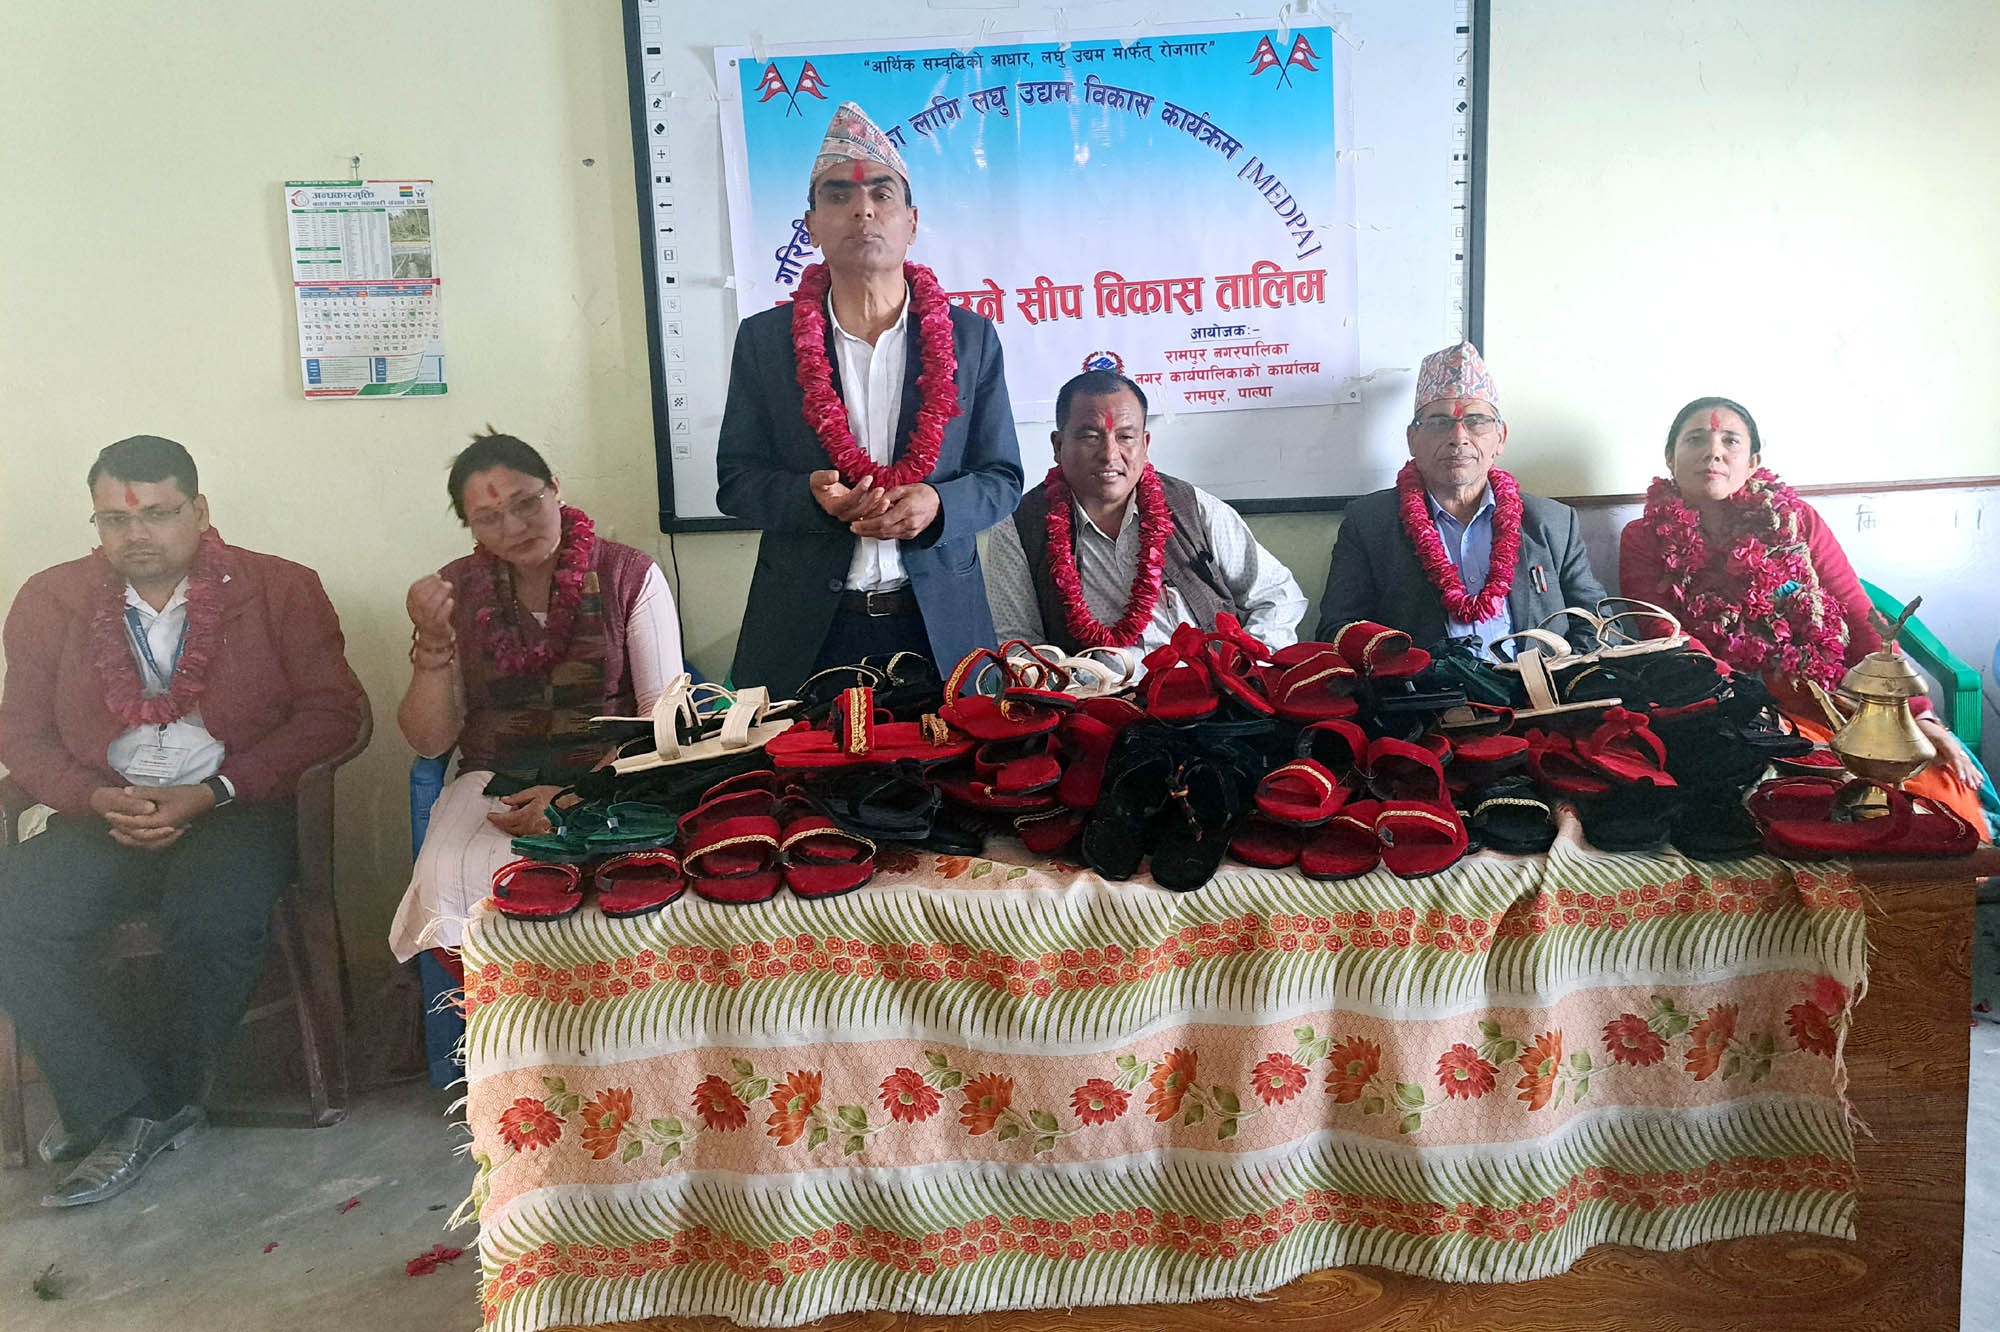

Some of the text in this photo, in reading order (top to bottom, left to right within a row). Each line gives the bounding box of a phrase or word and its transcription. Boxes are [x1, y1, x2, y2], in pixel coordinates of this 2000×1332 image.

[991, 52, 1034, 69] आधार,
[1041, 50, 1065, 68] लघु
[1072, 48, 1105, 63] उद्यम
[907, 95, 961, 136] लागि
[968, 86, 1009, 117] लघु
[1016, 82, 1074, 106] उद्यम
[1084, 74, 1155, 119] विकास
[1161, 102, 1243, 161] कार्यक्रम
[1237, 156, 1323, 261] [MEDPA]
[1015, 275, 1084, 325] सीप
[1093, 270, 1205, 316] विकास
[1215, 260, 1328, 312] तालिम
[1164, 341, 1289, 364] रामपुर नगरपालिका
[1135, 360, 1320, 386] नगर कार्यपालिकाको कार्यालय
[1238, 386, 1274, 398] पाल्पा
